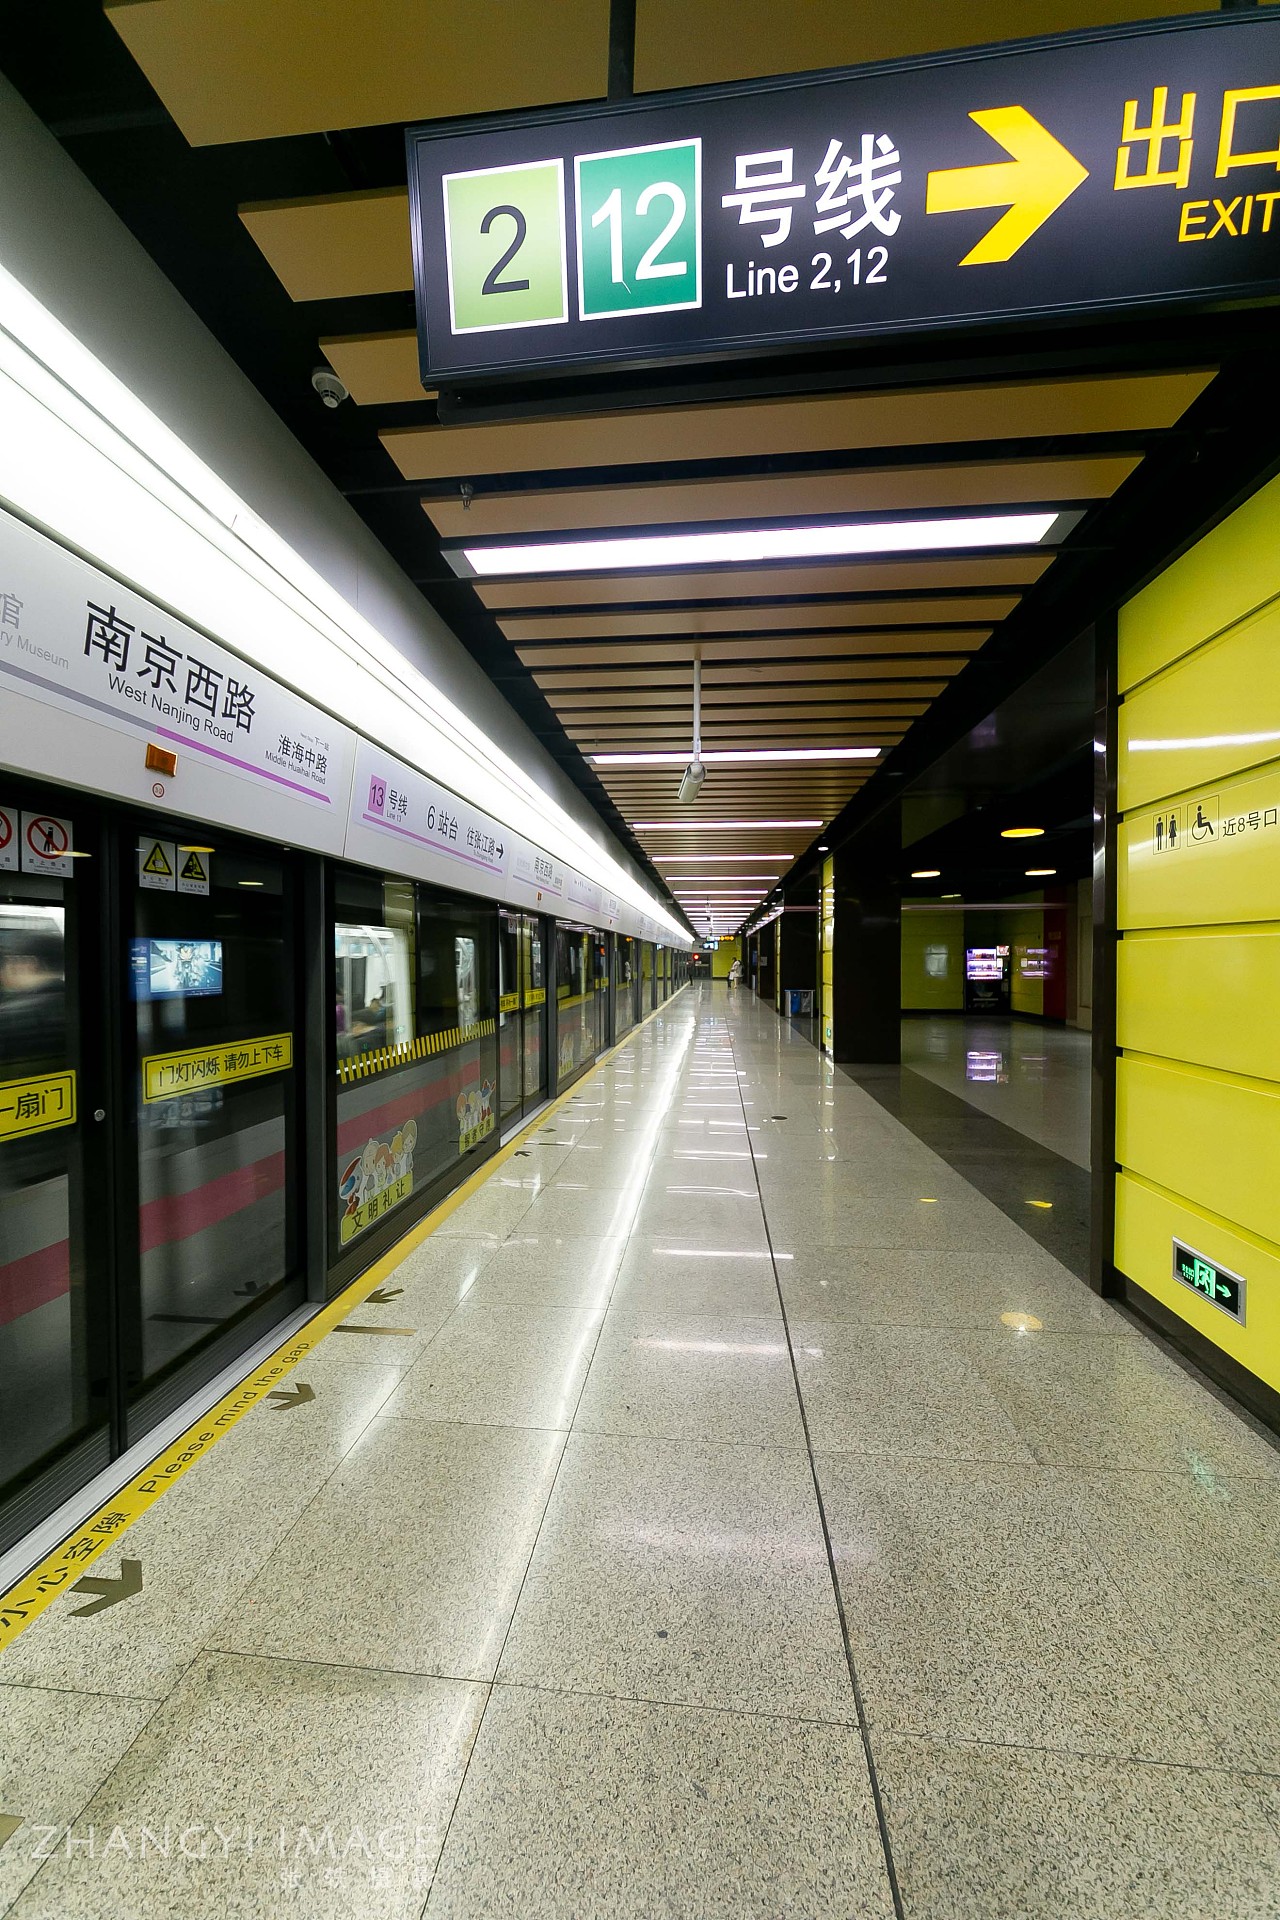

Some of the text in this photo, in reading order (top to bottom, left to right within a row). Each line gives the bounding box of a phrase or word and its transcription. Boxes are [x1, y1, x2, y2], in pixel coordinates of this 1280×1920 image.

[1114, 85, 1280, 191] 出口
[480, 133, 902, 297] 2 12 号线
[1177, 191, 1280, 242] EXIT
[726, 246, 889, 299] Line 2,12
[17, 634, 69, 670] Museum
[83, 600, 256, 734] 南京西路
[108, 672, 234, 744] West Nanjing Road
[264, 749, 327, 786] Middle Huaihai Road
[278, 733, 328, 775] 淮海中路
[371, 783, 408, 816] 13 号线
[1222, 808, 1277, 837] 近8号口
[159, 1044, 284, 1087] 门灯闪烁 请勿上下车
[352, 1179, 405, 1234] 文明礼让
[137, 1339, 314, 1494] Please mind the gap.
[0, 1511, 132, 1629] 小心空隙
